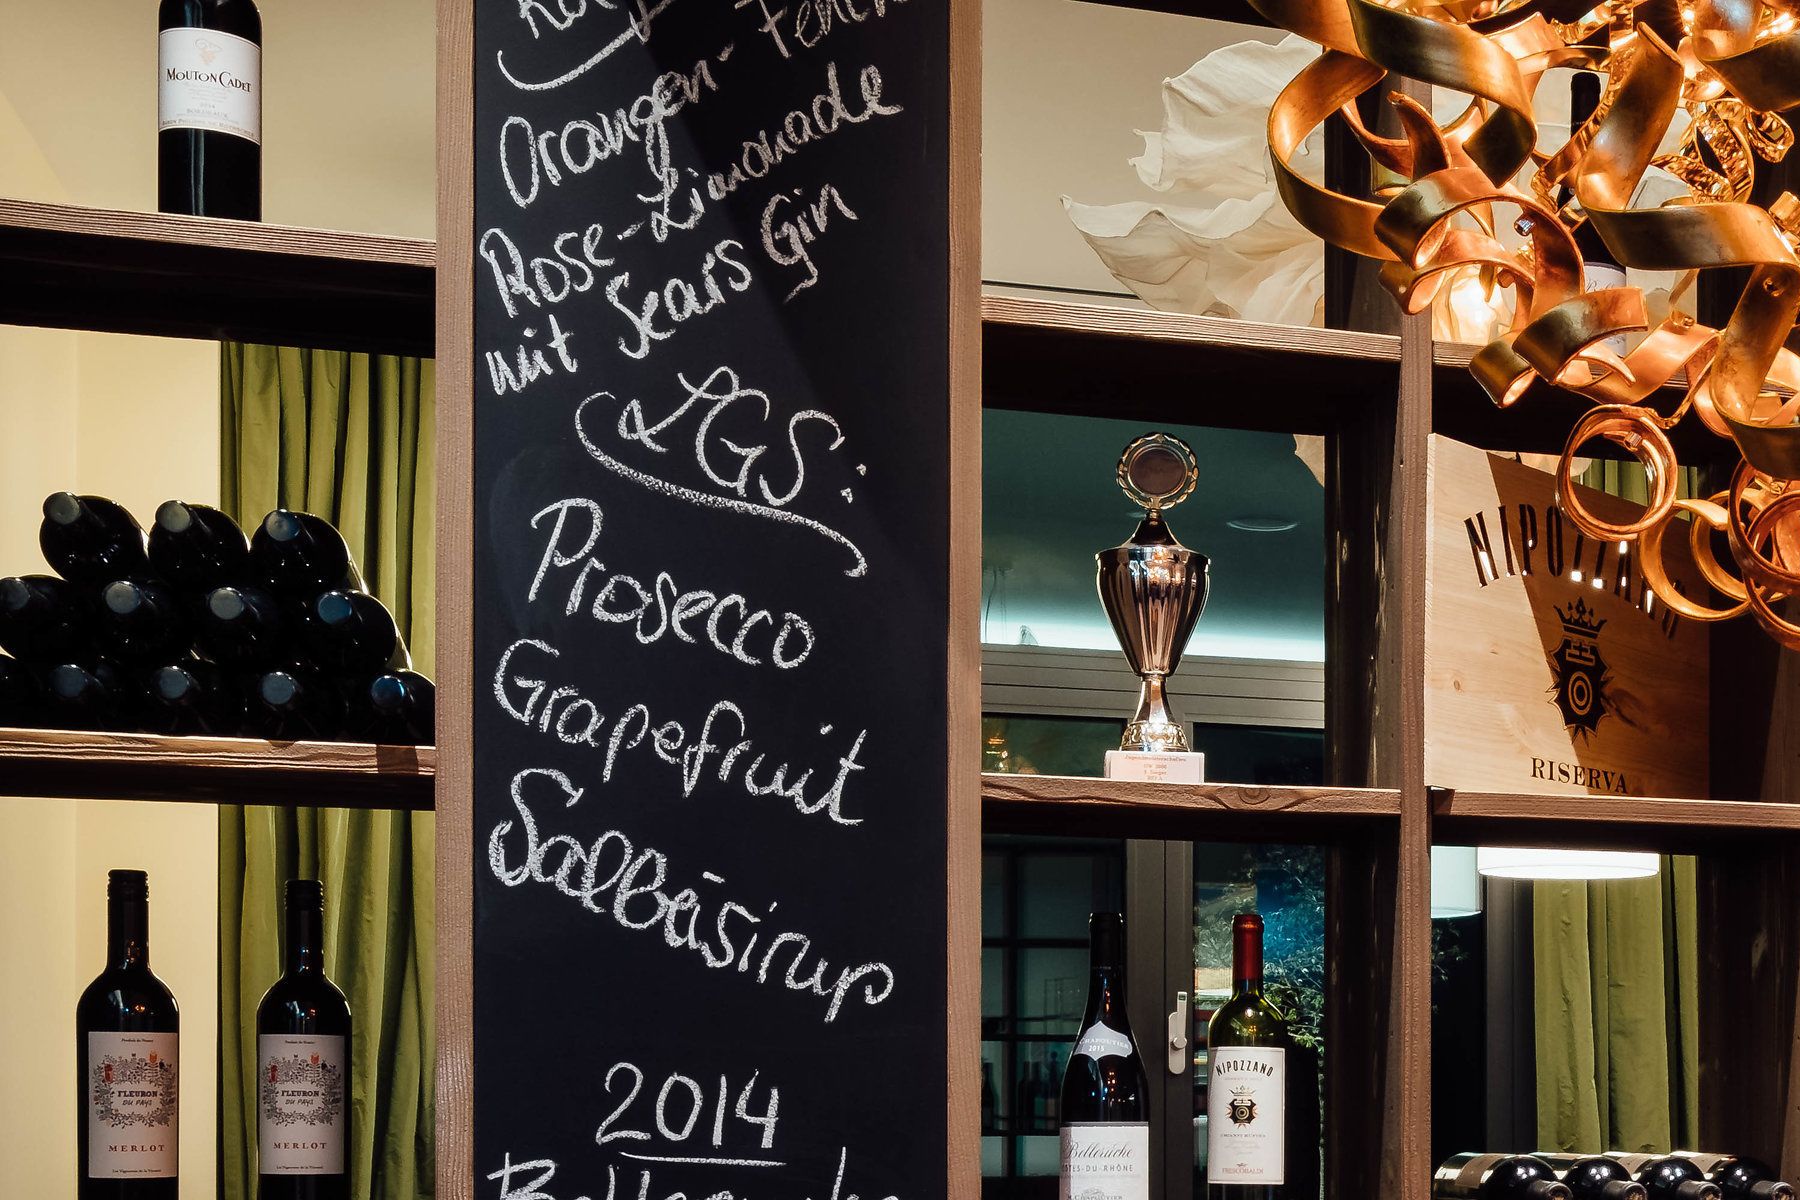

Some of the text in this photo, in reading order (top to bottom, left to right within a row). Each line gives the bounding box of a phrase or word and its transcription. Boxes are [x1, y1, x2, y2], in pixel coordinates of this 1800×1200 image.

[219, 71, 252, 93] CADET
[486, 184, 859, 395] mit Sears Gin
[528, 497, 816, 669] Prosecco
[493, 638, 867, 826] Grapefruit
[1530, 757, 1628, 794] RISERVA
[1215, 1059, 1274, 1077] NIPOZZANO
[596, 1062, 780, 1149] 2014
[108, 1144, 165, 1152] MERLOT
